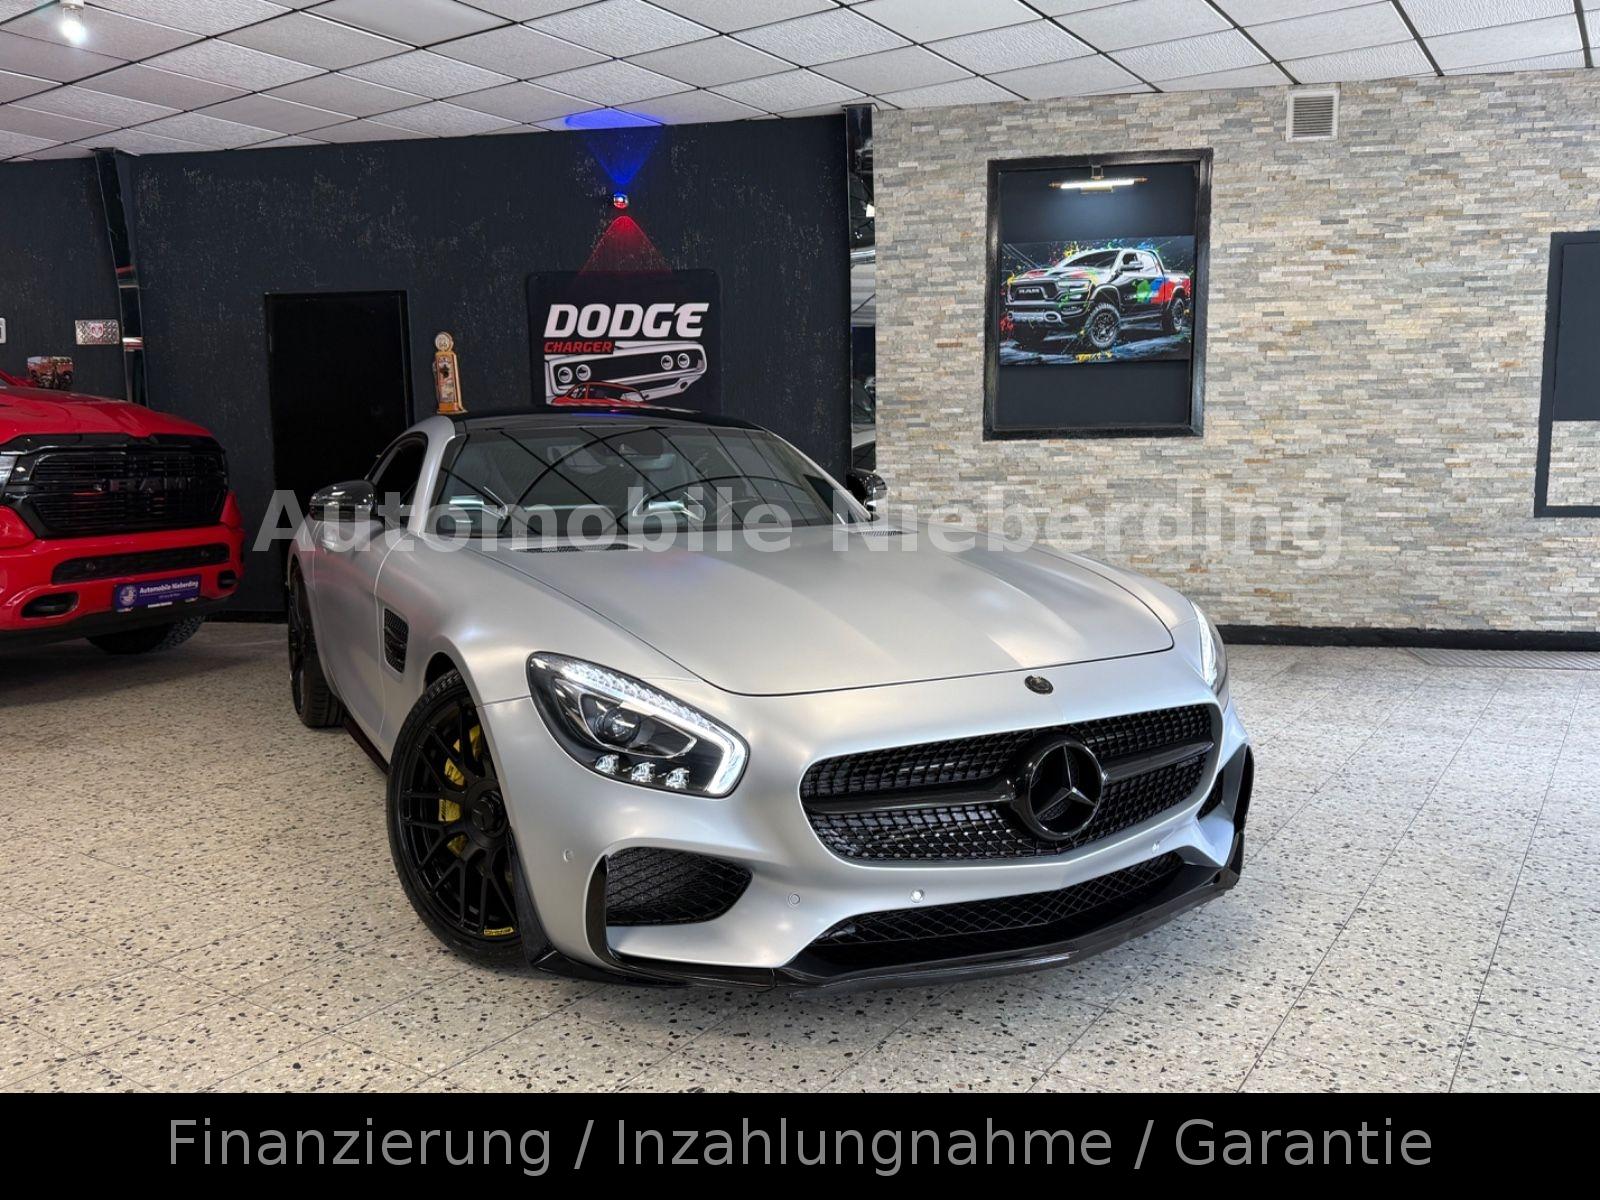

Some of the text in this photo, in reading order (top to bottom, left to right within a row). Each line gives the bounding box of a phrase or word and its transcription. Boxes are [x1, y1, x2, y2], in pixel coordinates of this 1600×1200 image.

[543, 303, 710, 338] DODGE
[544, 341, 613, 353] CHARGER
[110, 477, 188, 492] RAM
[140, 581, 199, 593] Automobile Nieberding
